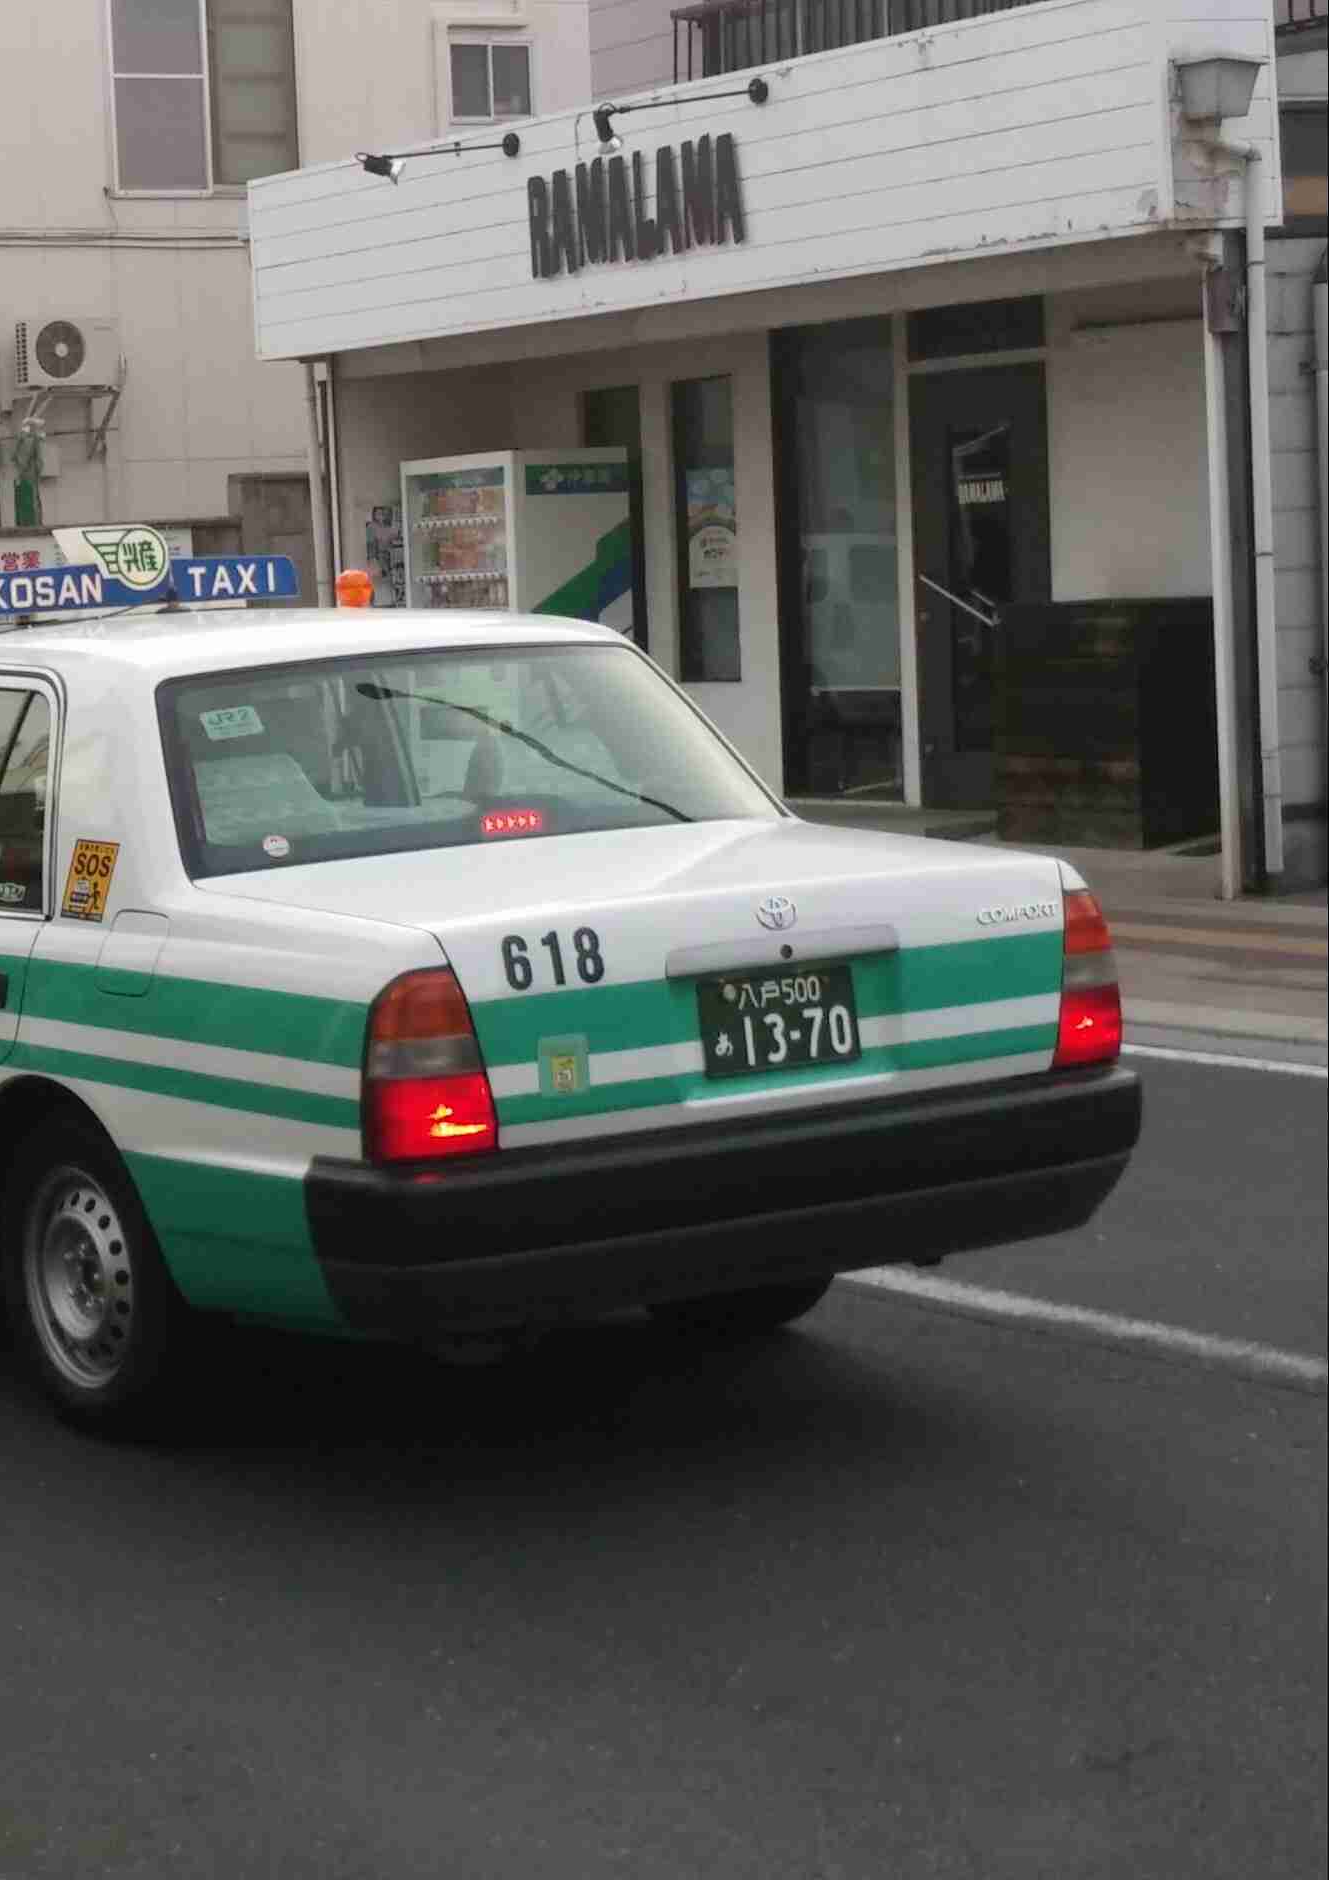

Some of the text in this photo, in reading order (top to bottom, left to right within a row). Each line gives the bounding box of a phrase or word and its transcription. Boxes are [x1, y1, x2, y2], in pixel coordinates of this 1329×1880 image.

[527, 132, 746, 279] RAMALAMA
[188, 561, 276, 597] TAXI
[74, 852, 112, 878] SOS
[502, 926, 605, 991] 618
[738, 976, 821, 1010] 八戸500
[715, 1005, 853, 1067] あ 13-70
